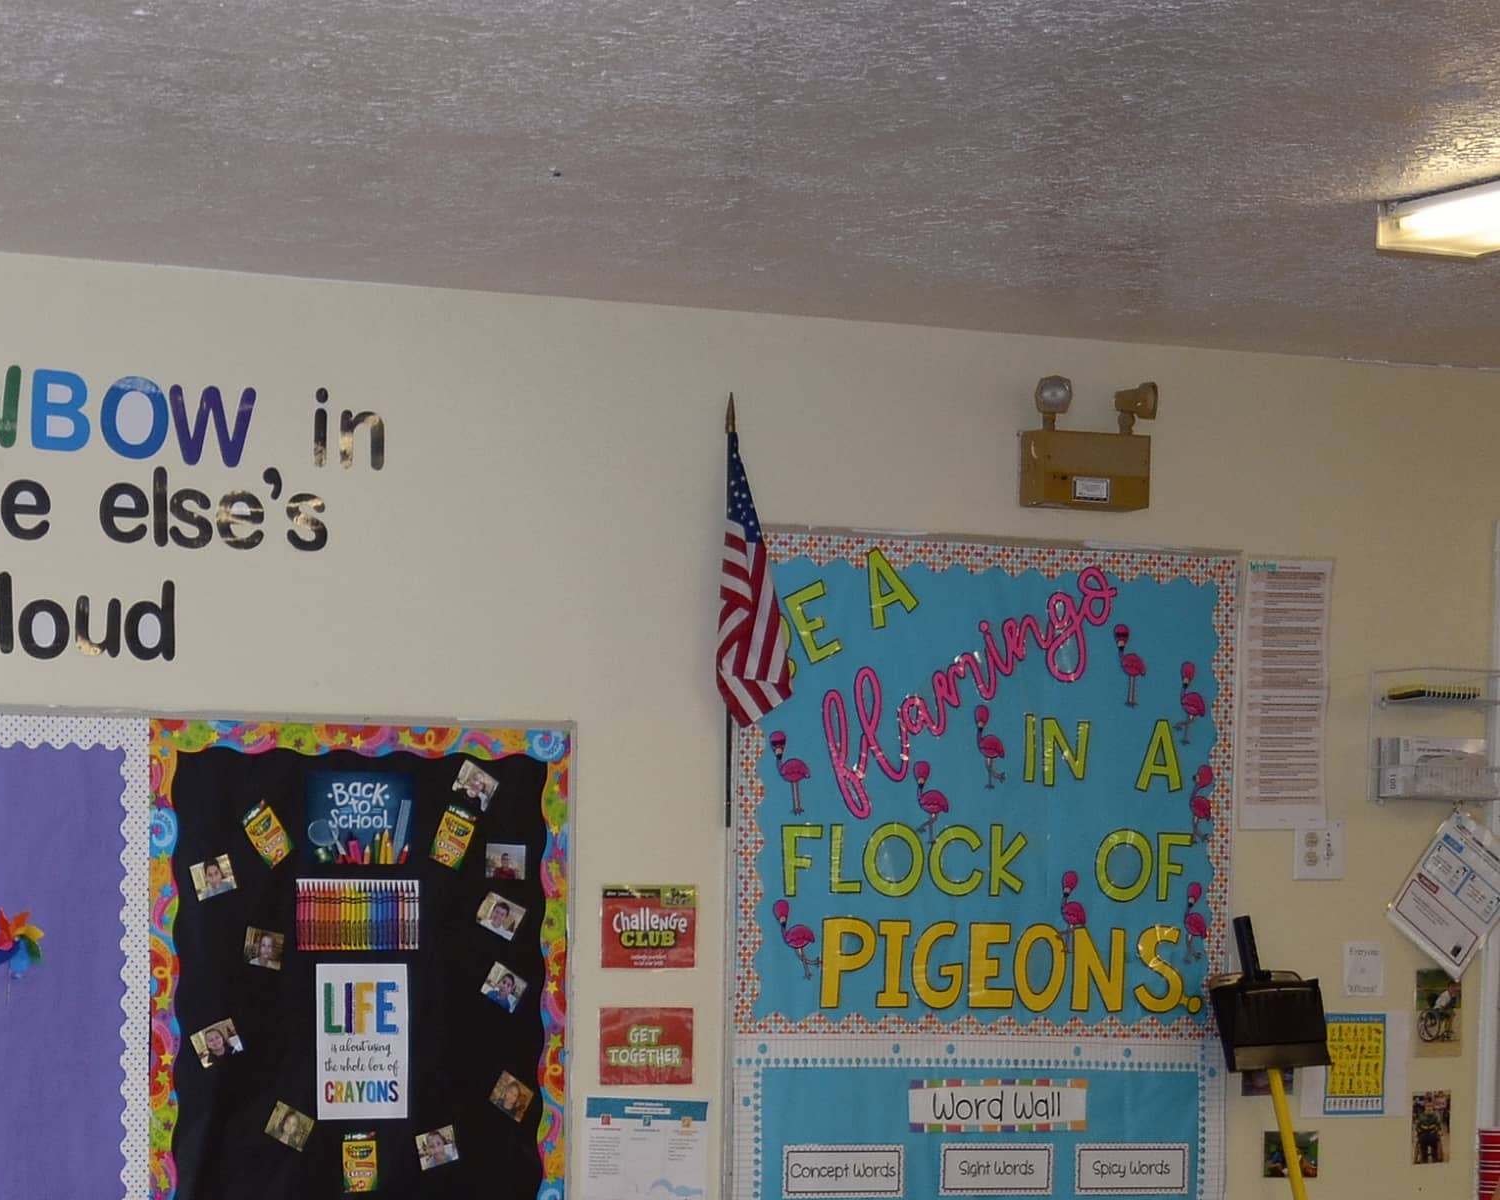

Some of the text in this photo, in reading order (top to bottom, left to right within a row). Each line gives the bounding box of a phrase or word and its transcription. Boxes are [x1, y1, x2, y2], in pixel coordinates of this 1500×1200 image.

[313, 388, 385, 470] in
[100, 467, 328, 551] else's
[868, 547, 919, 630] A
[822, 567, 1117, 819] flamingo
[1024, 713, 1183, 792] IN A
[328, 809, 392, 828] SCHOOL
[781, 822, 1193, 902] FLOCK OF
[620, 930, 676, 947] CLUB
[323, 982, 398, 1035] LIFE
[629, 1028, 661, 1043] GET
[339, 1038, 367, 1052] about
[368, 1043, 391, 1057] using
[608, 1048, 681, 1065] TOGETHER
[325, 1057, 399, 1077] the whole box of
[325, 1080, 399, 1103] CRAYONS
[932, 1091, 1061, 1122] Word Wall
[790, 1161, 896, 1180] Concept Words
[958, 1160, 1034, 1179] Sight Words
[1092, 1160, 1170, 1179] Spicy Words
